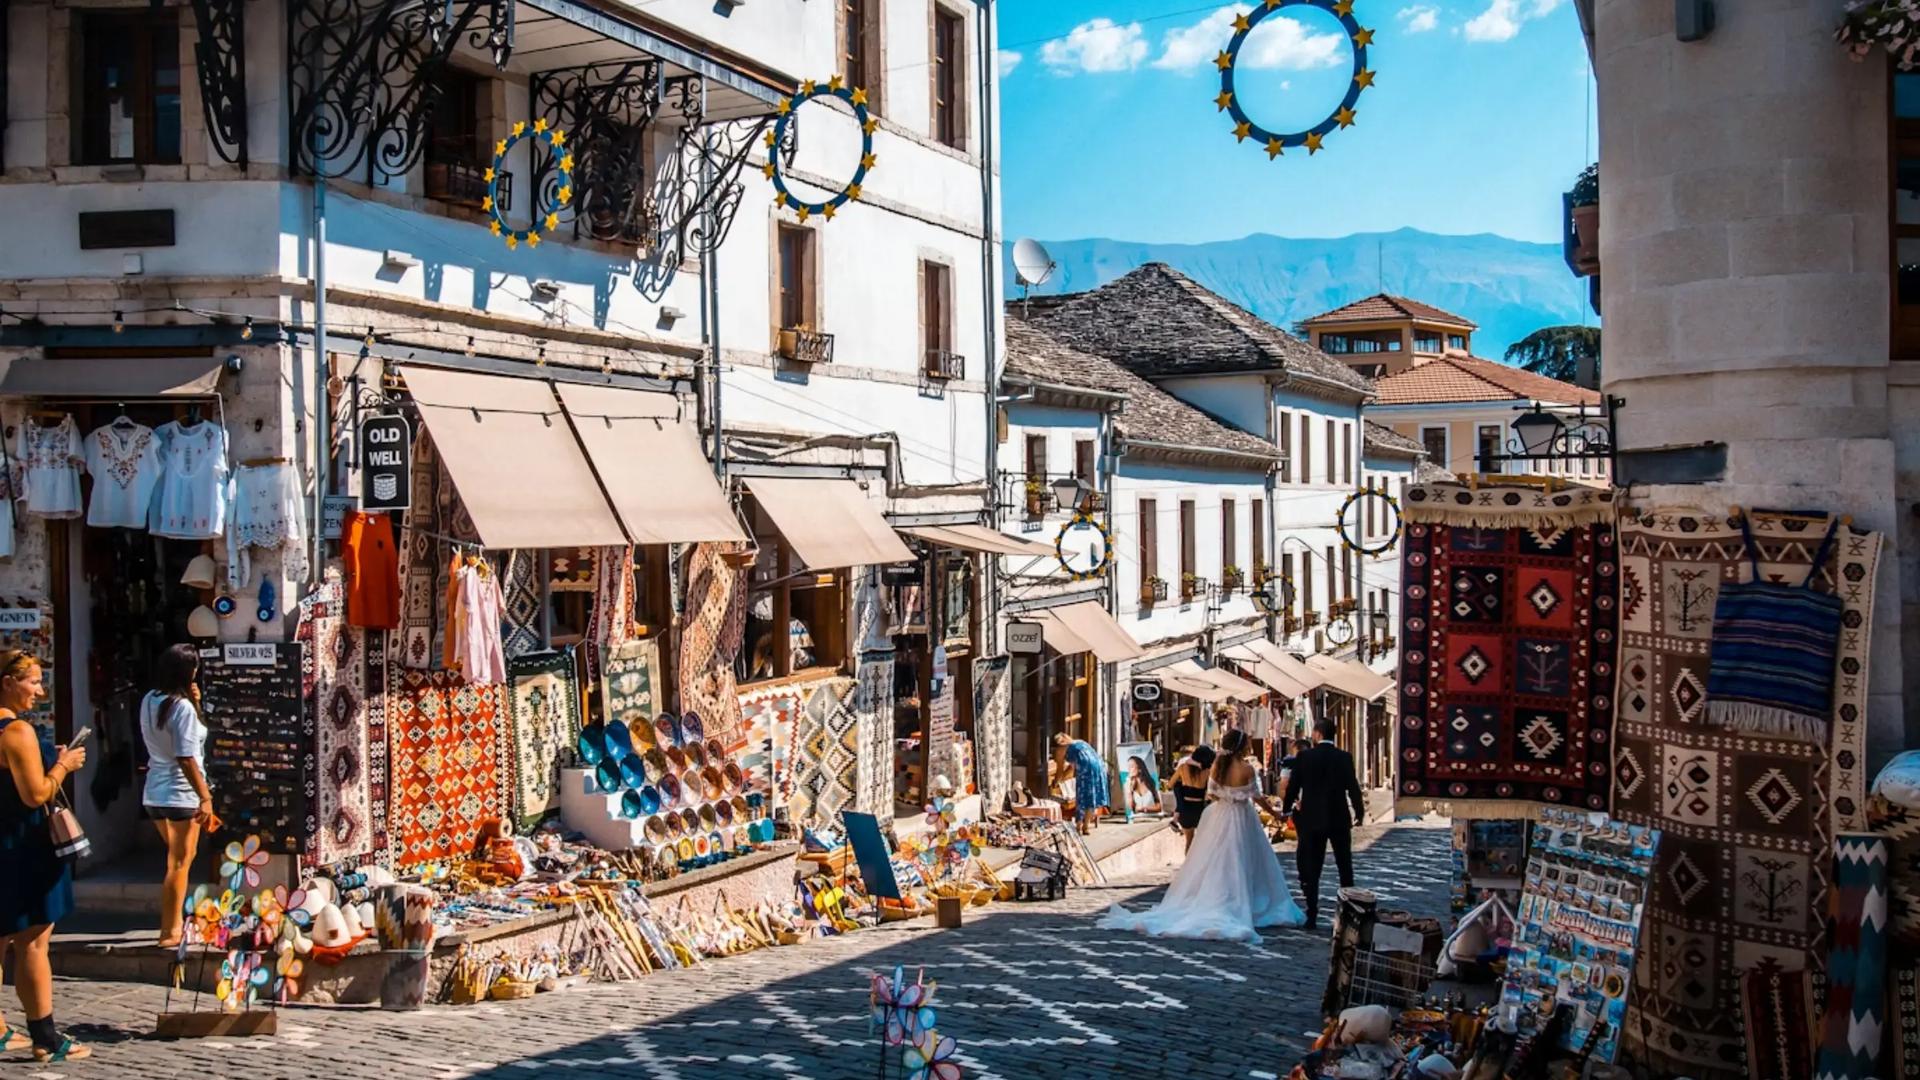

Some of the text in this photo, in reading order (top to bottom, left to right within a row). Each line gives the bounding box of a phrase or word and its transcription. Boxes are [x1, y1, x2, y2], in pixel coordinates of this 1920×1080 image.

[369, 428, 401, 443] OLD
[368, 450, 402, 466] WELL
[228, 647, 257, 658] SILVER
[258, 647, 273, 659] 925
